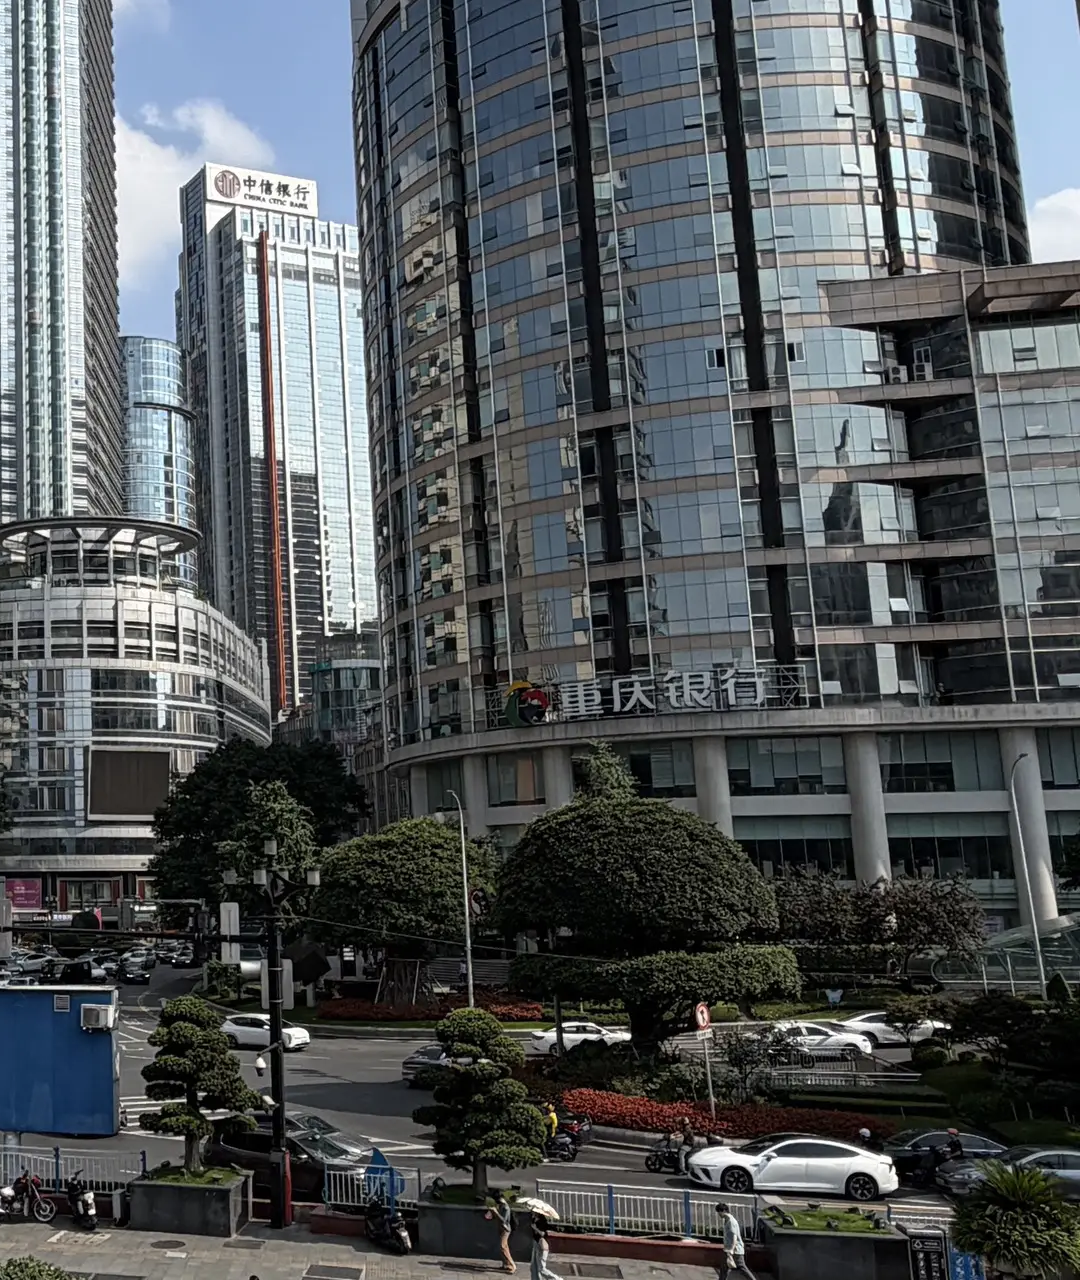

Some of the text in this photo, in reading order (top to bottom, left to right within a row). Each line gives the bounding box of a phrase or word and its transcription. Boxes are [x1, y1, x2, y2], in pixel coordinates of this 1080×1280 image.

[242, 175, 310, 202] 中信银行
[243, 193, 309, 210] CHINA CITIC BANK
[560, 668, 766, 718] 重庆银行
